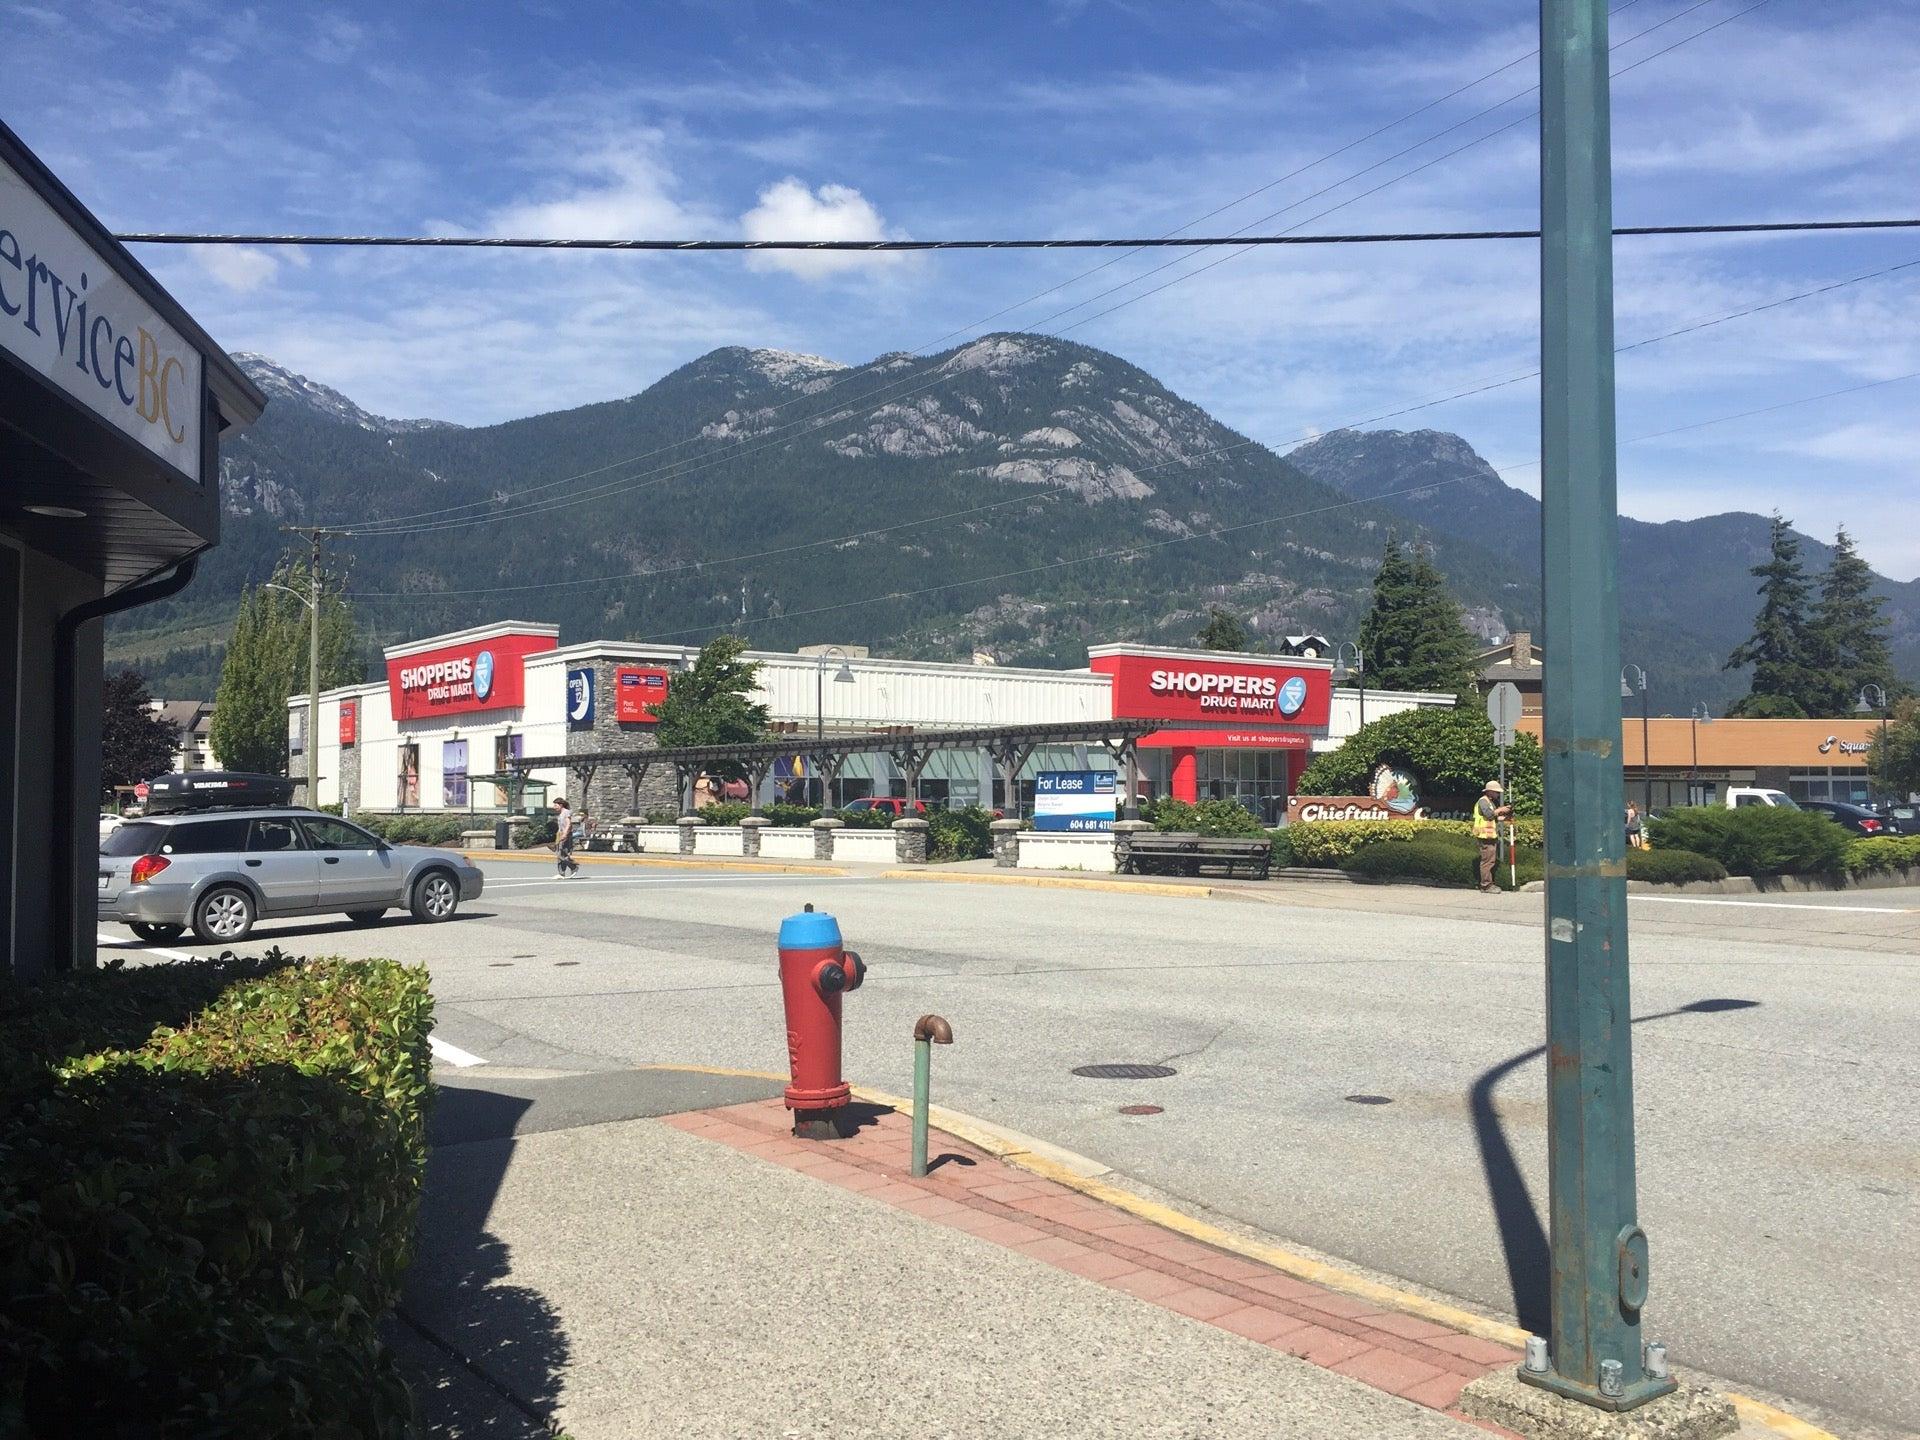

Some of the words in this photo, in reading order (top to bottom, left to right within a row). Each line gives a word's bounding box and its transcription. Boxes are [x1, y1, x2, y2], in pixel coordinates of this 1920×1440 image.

[400, 658, 473, 689] SHOPPERS
[569, 679, 583, 689] OPEN
[1150, 670, 1277, 696] SHOPPERS
[427, 686, 450, 701] DRUG
[450, 682, 473, 698] MART
[1200, 695, 1237, 708] DRUG
[1240, 698, 1276, 710] MART
[1227, 734, 1241, 742] Visit
[1038, 776, 1054, 789] For
[1056, 776, 1083, 789] Lease
[1302, 805, 1389, 821] Chieftain
[1070, 820, 1083, 829] 604
[1085, 820, 1097, 829] 681
